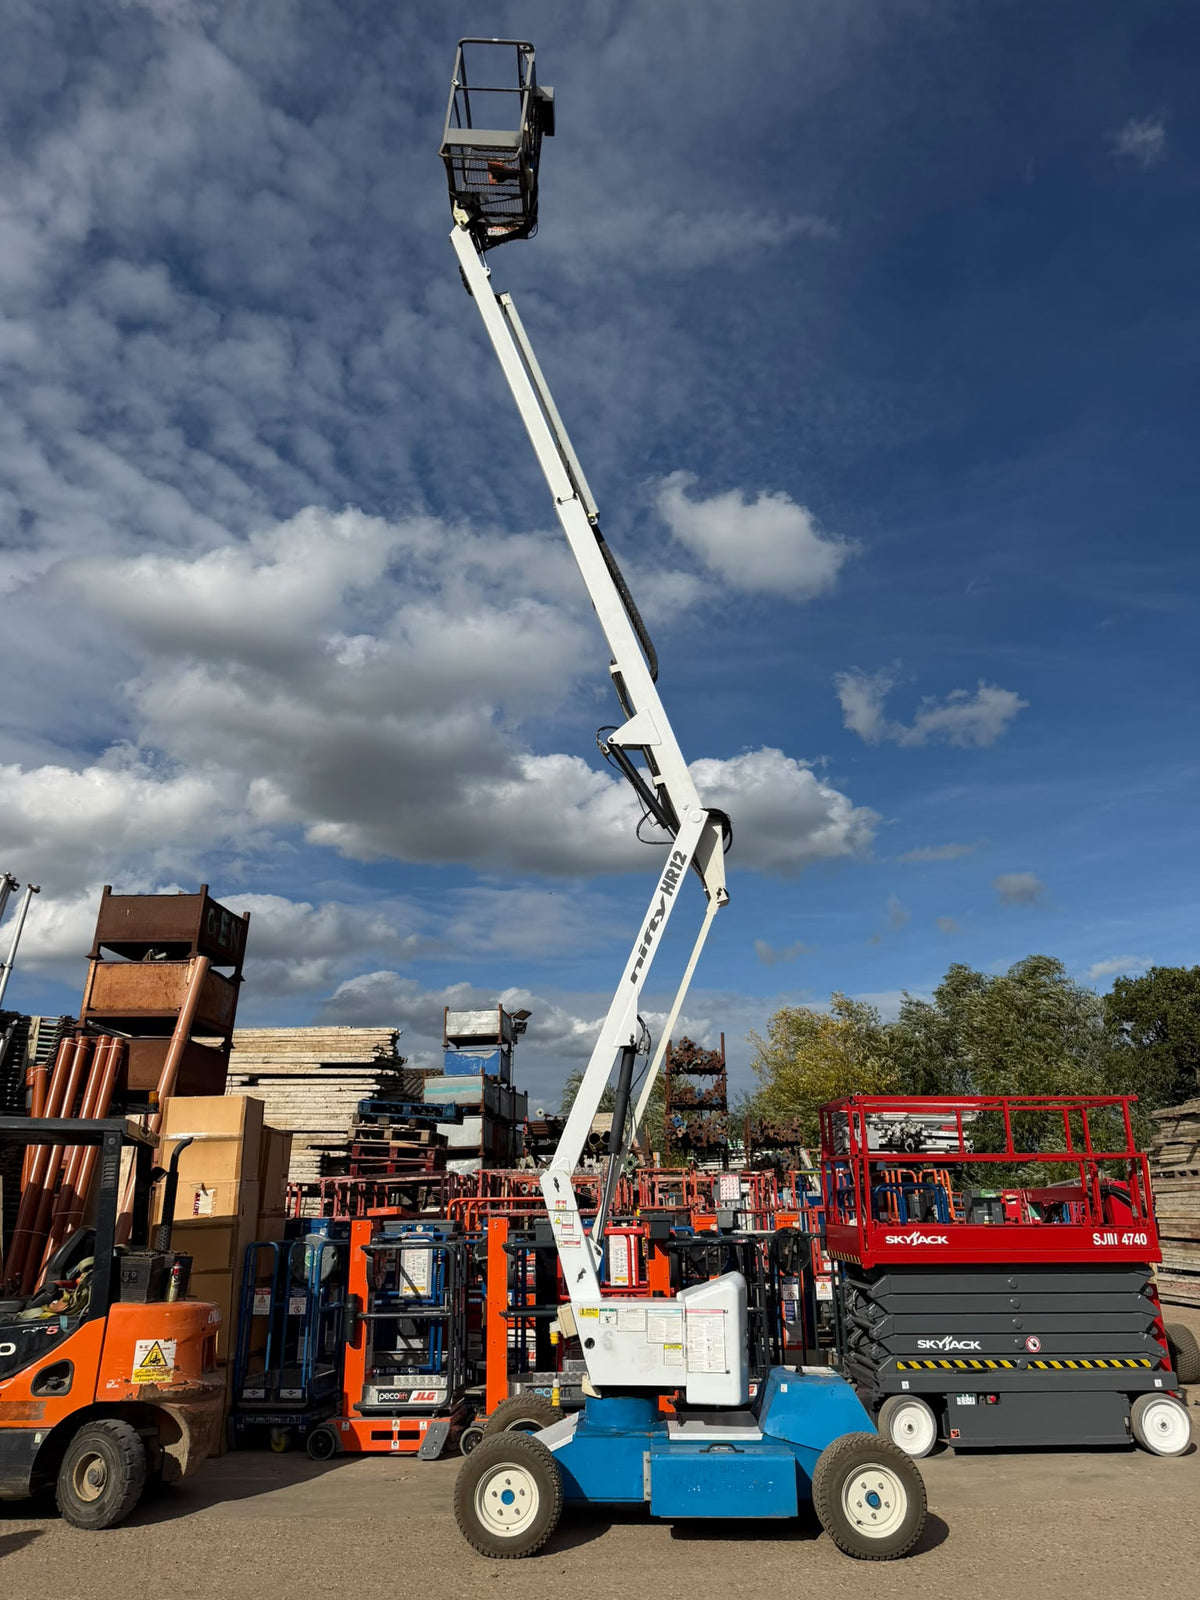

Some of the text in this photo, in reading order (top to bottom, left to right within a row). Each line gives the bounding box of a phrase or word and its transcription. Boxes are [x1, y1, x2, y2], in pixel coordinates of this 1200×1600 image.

[630, 850, 687, 984] nifty HR12
[885, 1231, 949, 1246] SKYJACK
[1121, 1233, 1147, 1246] 4740
[917, 1335, 982, 1351] SKYJACK
[413, 1391, 437, 1401] JLG
